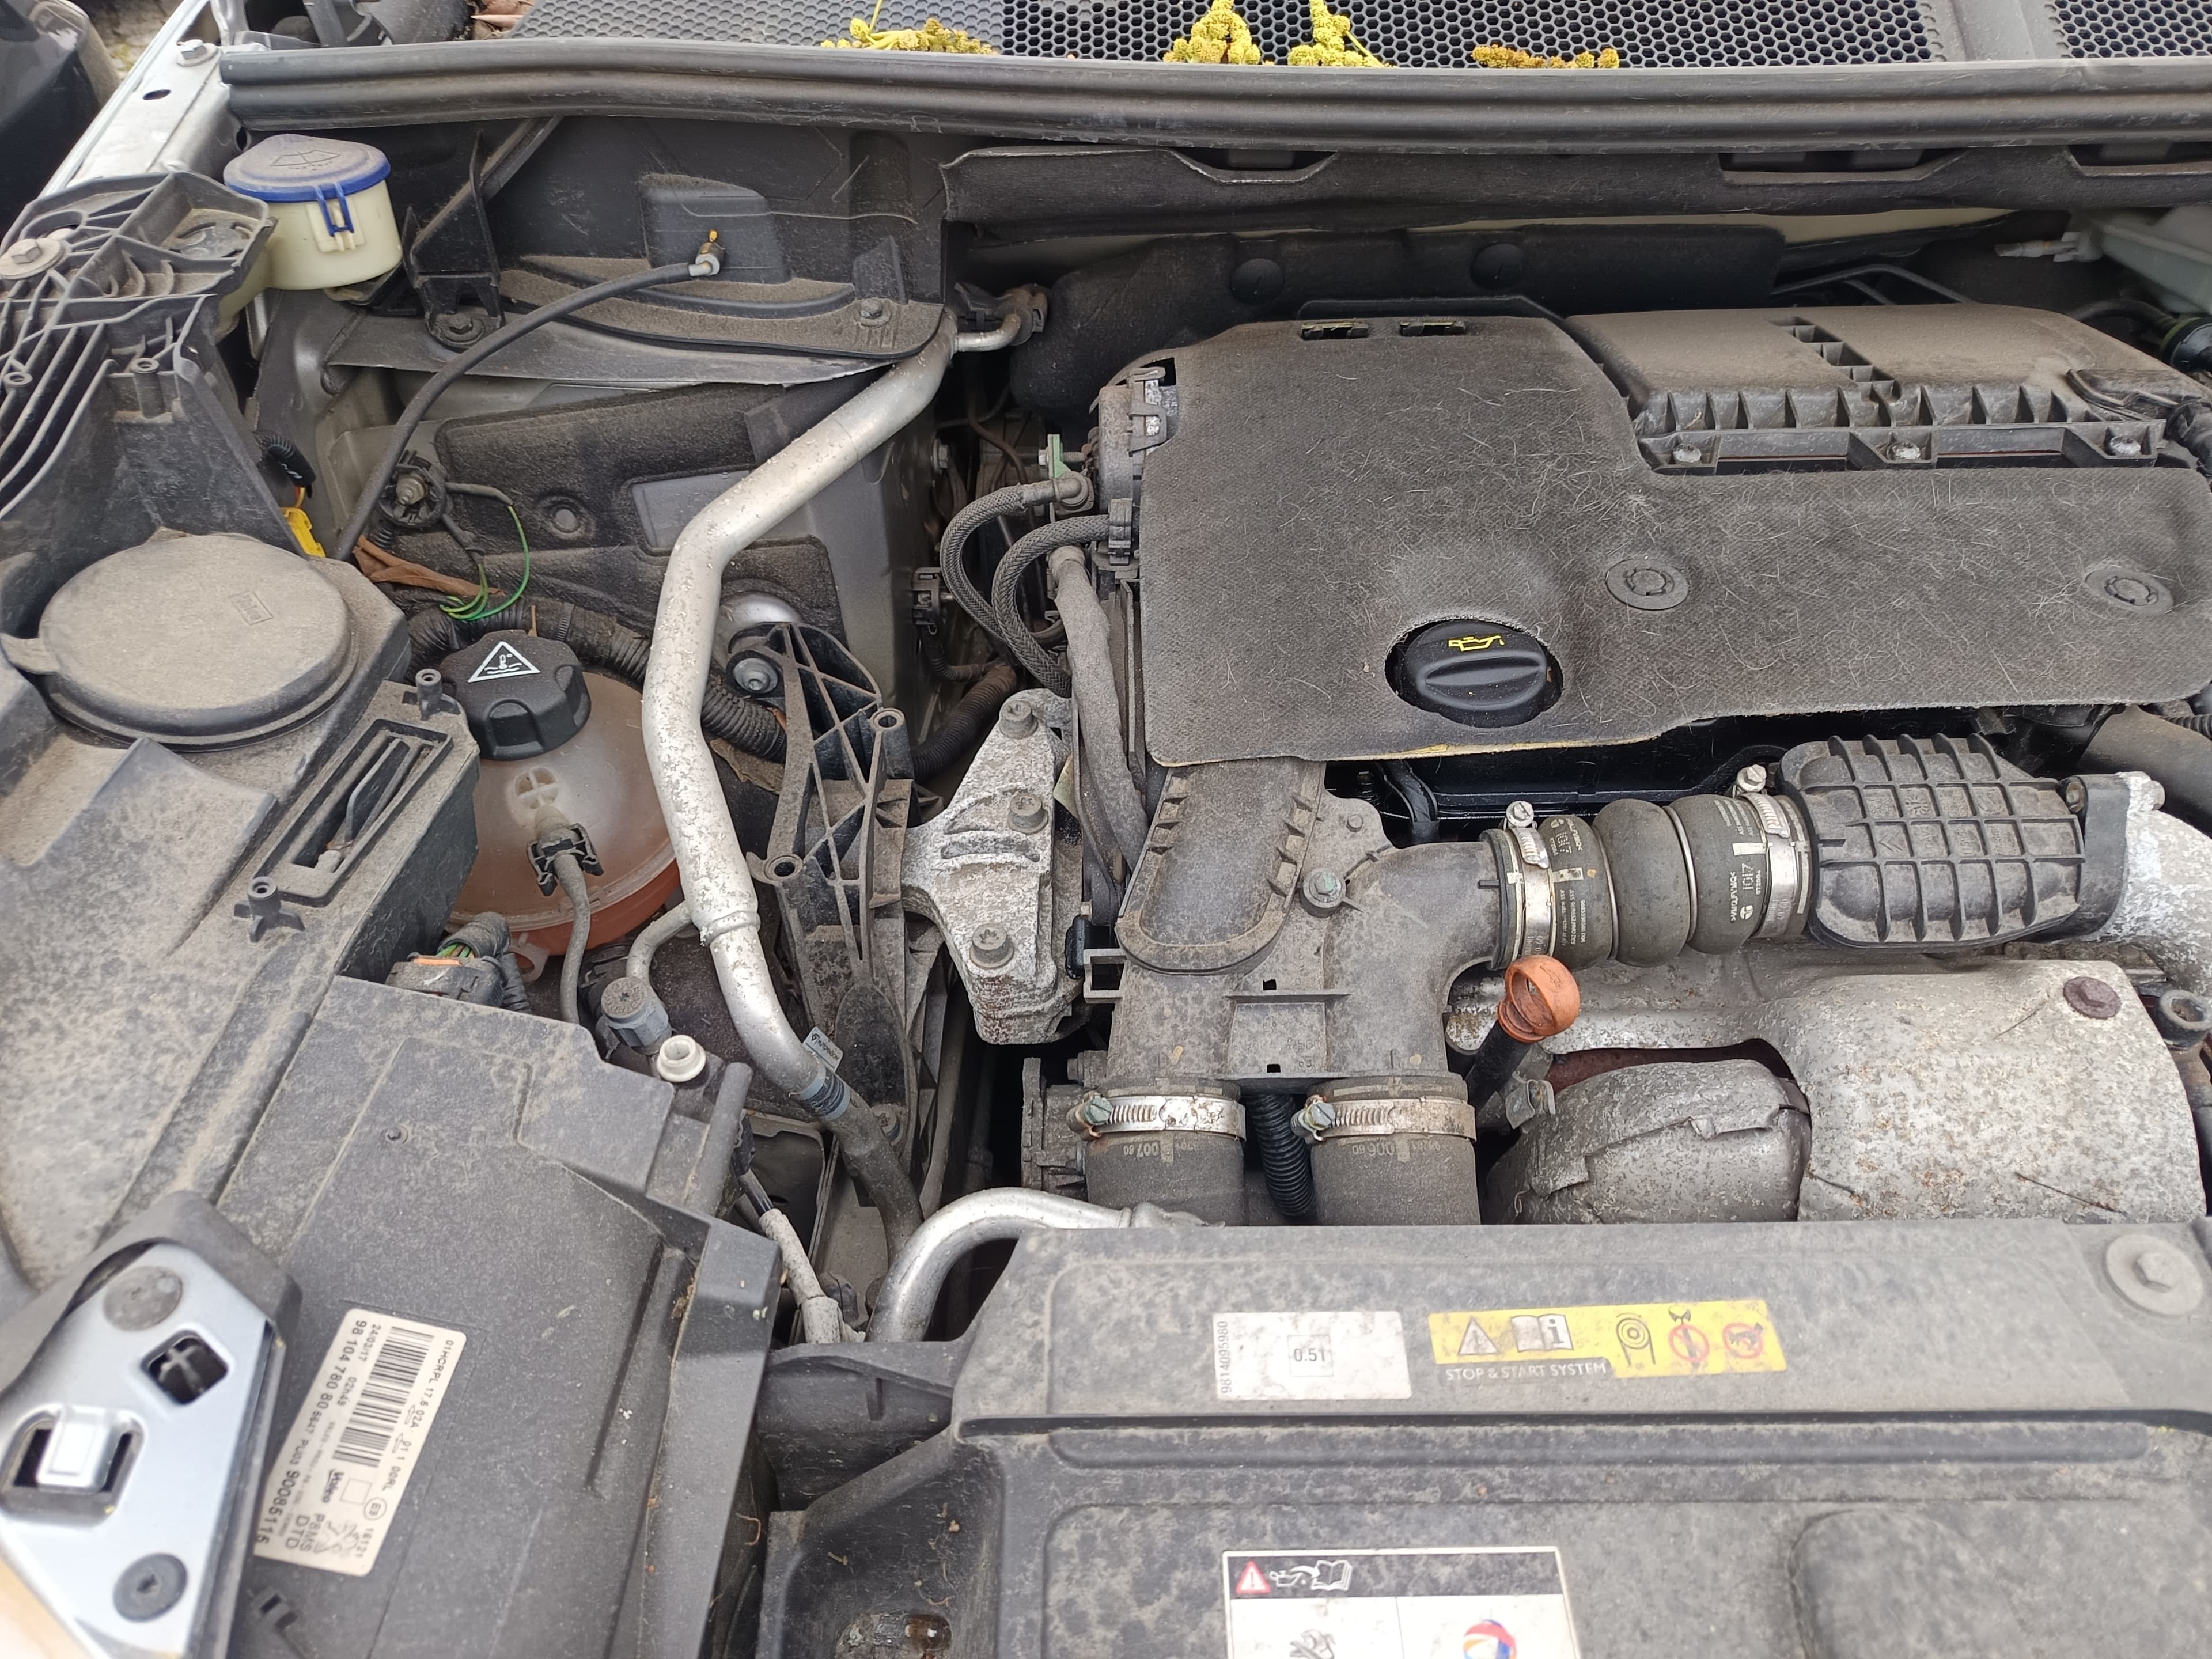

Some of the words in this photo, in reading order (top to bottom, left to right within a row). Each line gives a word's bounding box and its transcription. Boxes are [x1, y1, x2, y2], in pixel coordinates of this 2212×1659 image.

[1741, 862, 1753, 890] 1017
[351, 1320, 367, 1335] 98
[338, 1340, 357, 1361] 104
[1217, 1321, 1232, 1394] 9814095980
[1294, 1347, 1327, 1363] 0.51
[325, 1365, 346, 1389] 780
[1445, 1368, 1484, 1381] STOP
[1488, 1368, 1498, 1379] &
[1501, 1365, 1546, 1378] START
[1550, 1362, 1607, 1377] SYSTEM
[316, 1392, 332, 1409] 80
[285, 1514, 310, 1549] DTD
